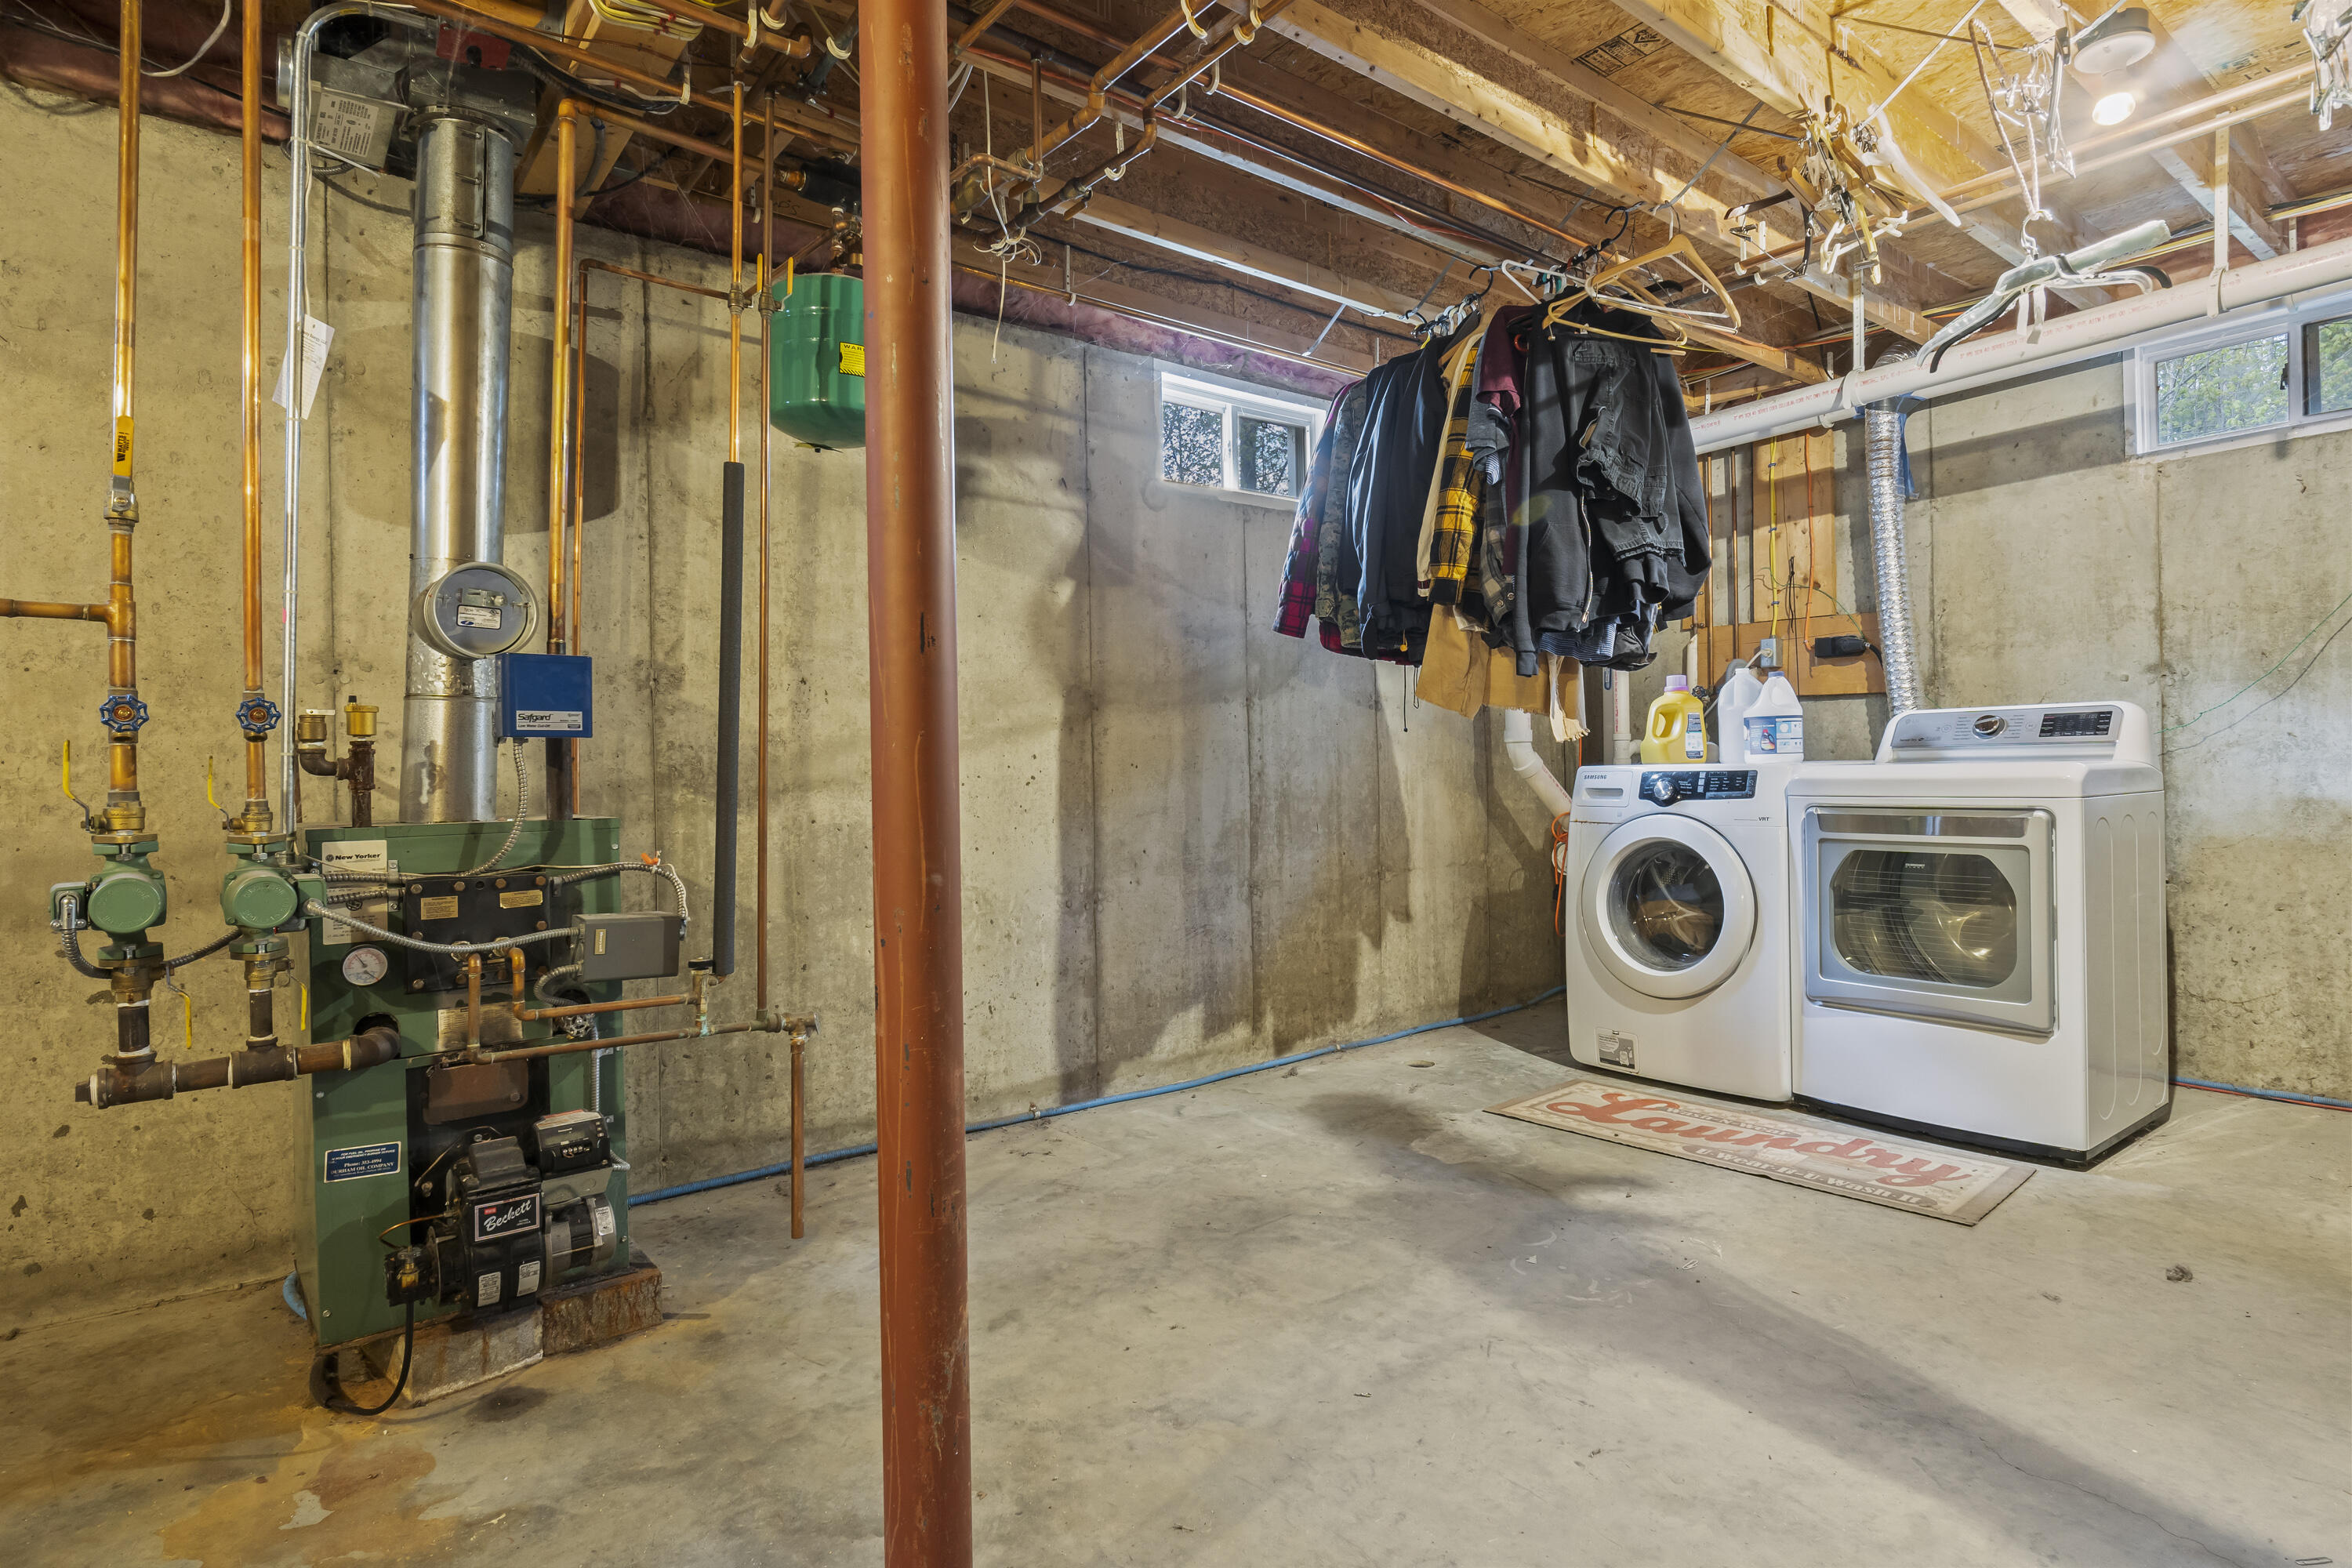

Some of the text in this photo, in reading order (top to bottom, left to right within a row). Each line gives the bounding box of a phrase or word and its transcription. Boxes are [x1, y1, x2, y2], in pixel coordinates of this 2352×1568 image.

[517, 713, 552, 723] Safgard
[1546, 1093, 1972, 1187] Laundry
[484, 1199, 532, 1232] Beckett
